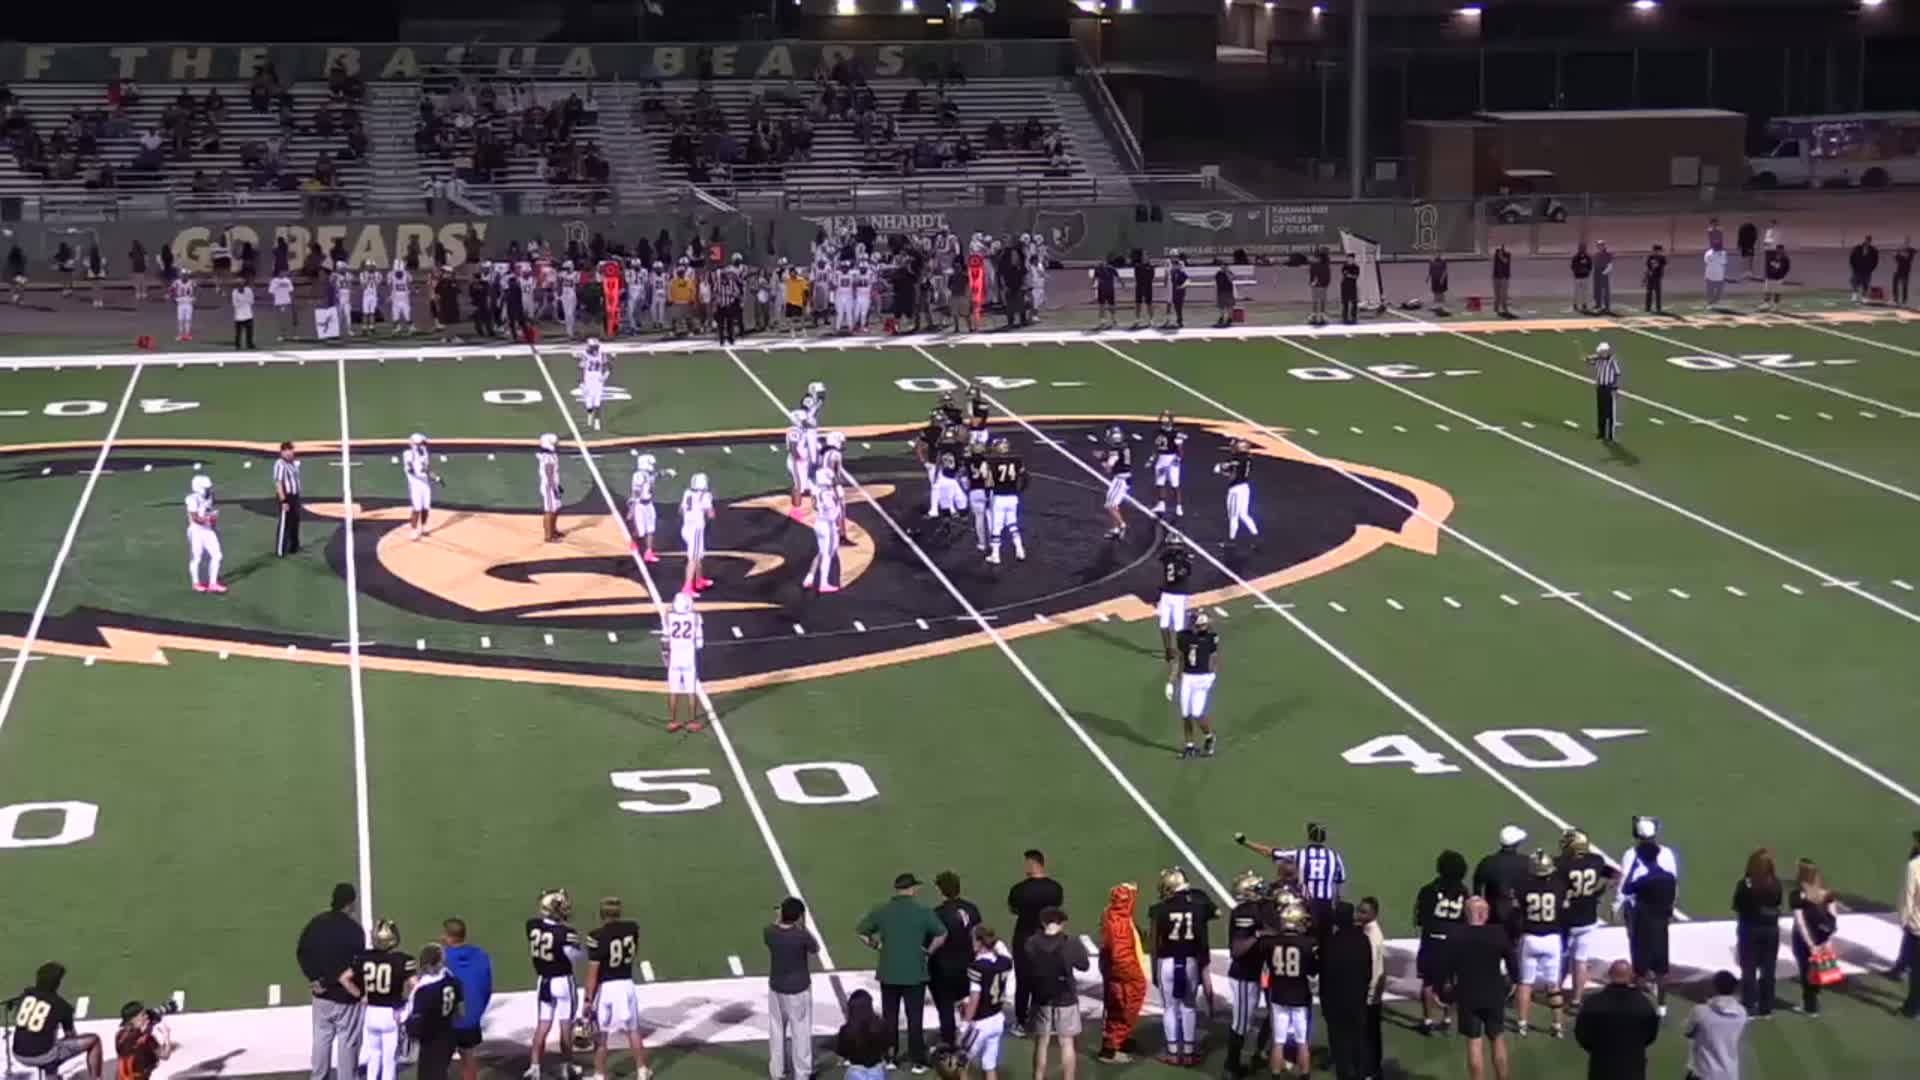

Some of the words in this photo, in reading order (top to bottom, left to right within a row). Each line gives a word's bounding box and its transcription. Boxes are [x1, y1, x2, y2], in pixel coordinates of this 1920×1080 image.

[109, 47, 269, 80] THE
[997, 462, 1017, 483] 74
[671, 620, 692, 640] 22
[1335, 727, 1600, 774] 40
[608, 761, 880, 813] 50
[1308, 857, 1328, 880] H
[1568, 868, 1597, 898] 32
[1525, 892, 1557, 923] 28
[1167, 911, 1196, 941] 71
[529, 927, 555, 962] 22
[608, 935, 636, 968] 83
[362, 960, 393, 995] 20
[1272, 946, 1300, 977] 48
[15, 995, 52, 1033] 88
